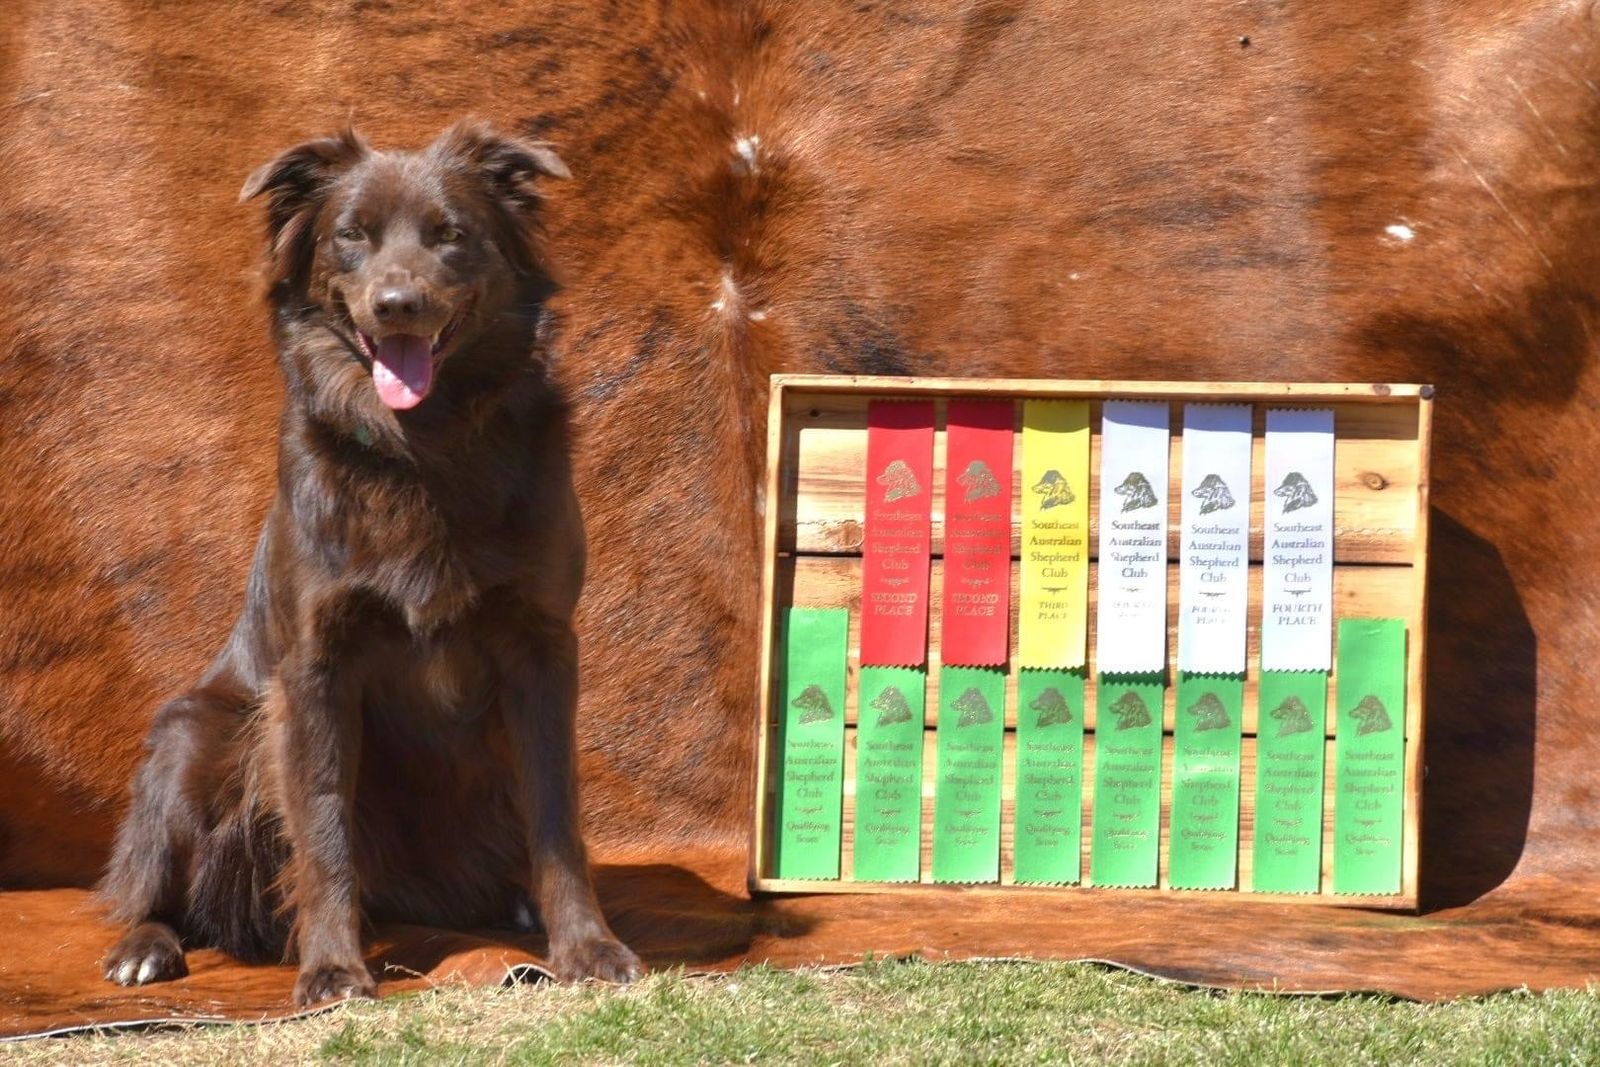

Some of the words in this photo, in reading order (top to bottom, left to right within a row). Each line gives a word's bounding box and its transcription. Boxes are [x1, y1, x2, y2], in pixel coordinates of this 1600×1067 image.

[1032, 520, 1079, 529] Southeast
[1111, 520, 1160, 530] Southeast
[1191, 524, 1240, 534] Southeast
[1273, 522, 1322, 532] Southeast
[1029, 536, 1082, 546] Australian
[1108, 536, 1162, 546] Australian
[1188, 541, 1241, 551] Australian
[1271, 538, 1325, 549] Australian
[1030, 552, 1080, 565] Shepherd
[1110, 552, 1160, 565] Shepherd
[1189, 556, 1239, 569] Shepherd
[1272, 554, 1322, 568] Shepherd
[1041, 568, 1068, 577] Club
[1121, 567, 1148, 578] Club
[1200, 572, 1227, 582] Club
[1284, 572, 1311, 582] Club
[874, 605, 913, 616] PLACE
[1272, 603, 1322, 613] FOURTH
[1278, 616, 1316, 625] PLACE
[785, 755, 837, 765] Australian
[785, 771, 834, 785] Shepherd
[796, 788, 823, 798] Club
[875, 790, 901, 800] Club
